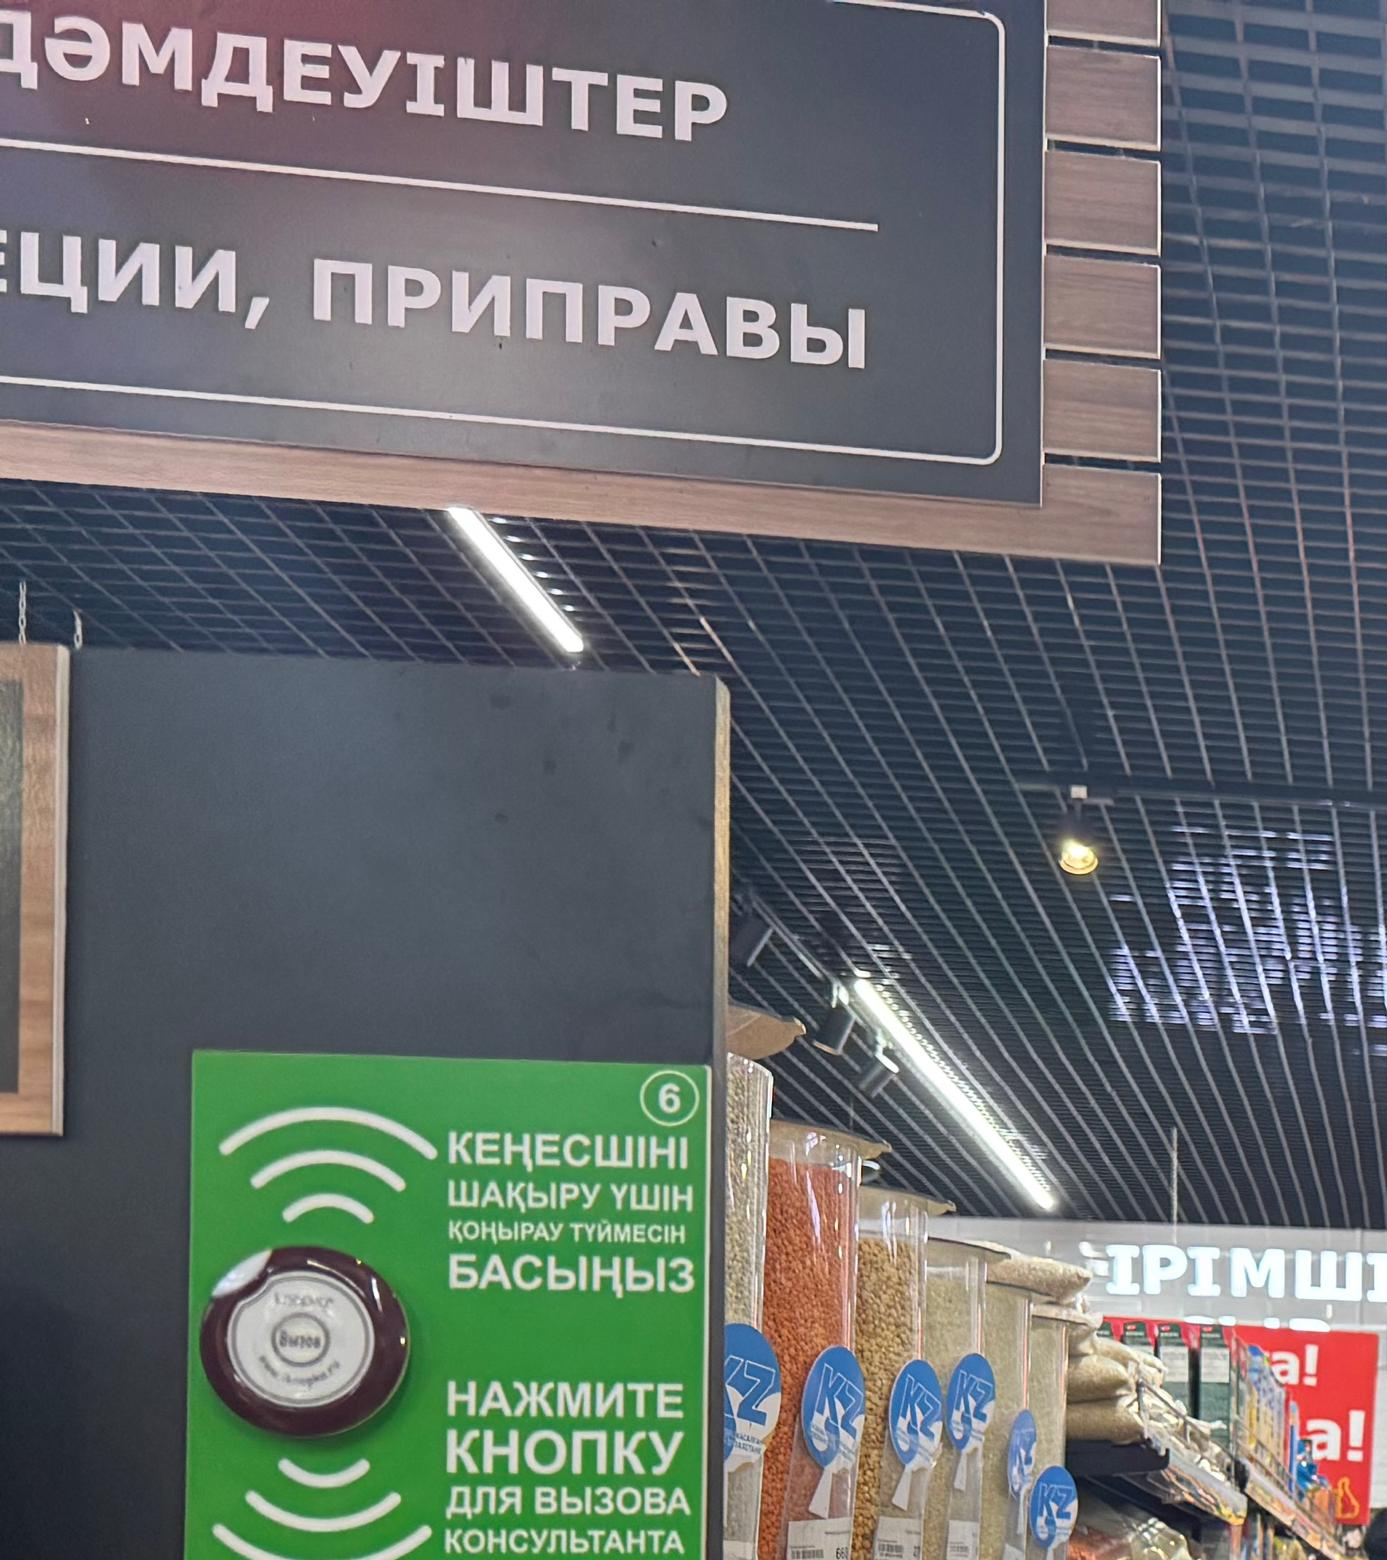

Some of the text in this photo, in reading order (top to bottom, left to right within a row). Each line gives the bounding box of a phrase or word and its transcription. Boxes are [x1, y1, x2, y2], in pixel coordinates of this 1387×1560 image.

[0, 9, 728, 143] ДӘМДЕУІШТЕР
[0, 229, 865, 370] ЦИИ, ПРИПРАВЫ
[657, 1083, 681, 1114] 6
[448, 1131, 688, 1171] КЕҢЕСШІНІ
[448, 1180, 694, 1213] ШАҚЫРУ ҮШІН
[448, 1220, 686, 1247] ҚОҢЫРАУ ТҮЙМЕСІН
[448, 1254, 695, 1299] БАСЫҢЫЗ
[447, 1381, 684, 1419] НАЖМИТЕ
[446, 1430, 684, 1475] КНОПКУ
[445, 1487, 691, 1519] ДЛЯ ВЫЗОВА
[444, 1529, 685, 1554] КОНСУЛЬТАНТА
